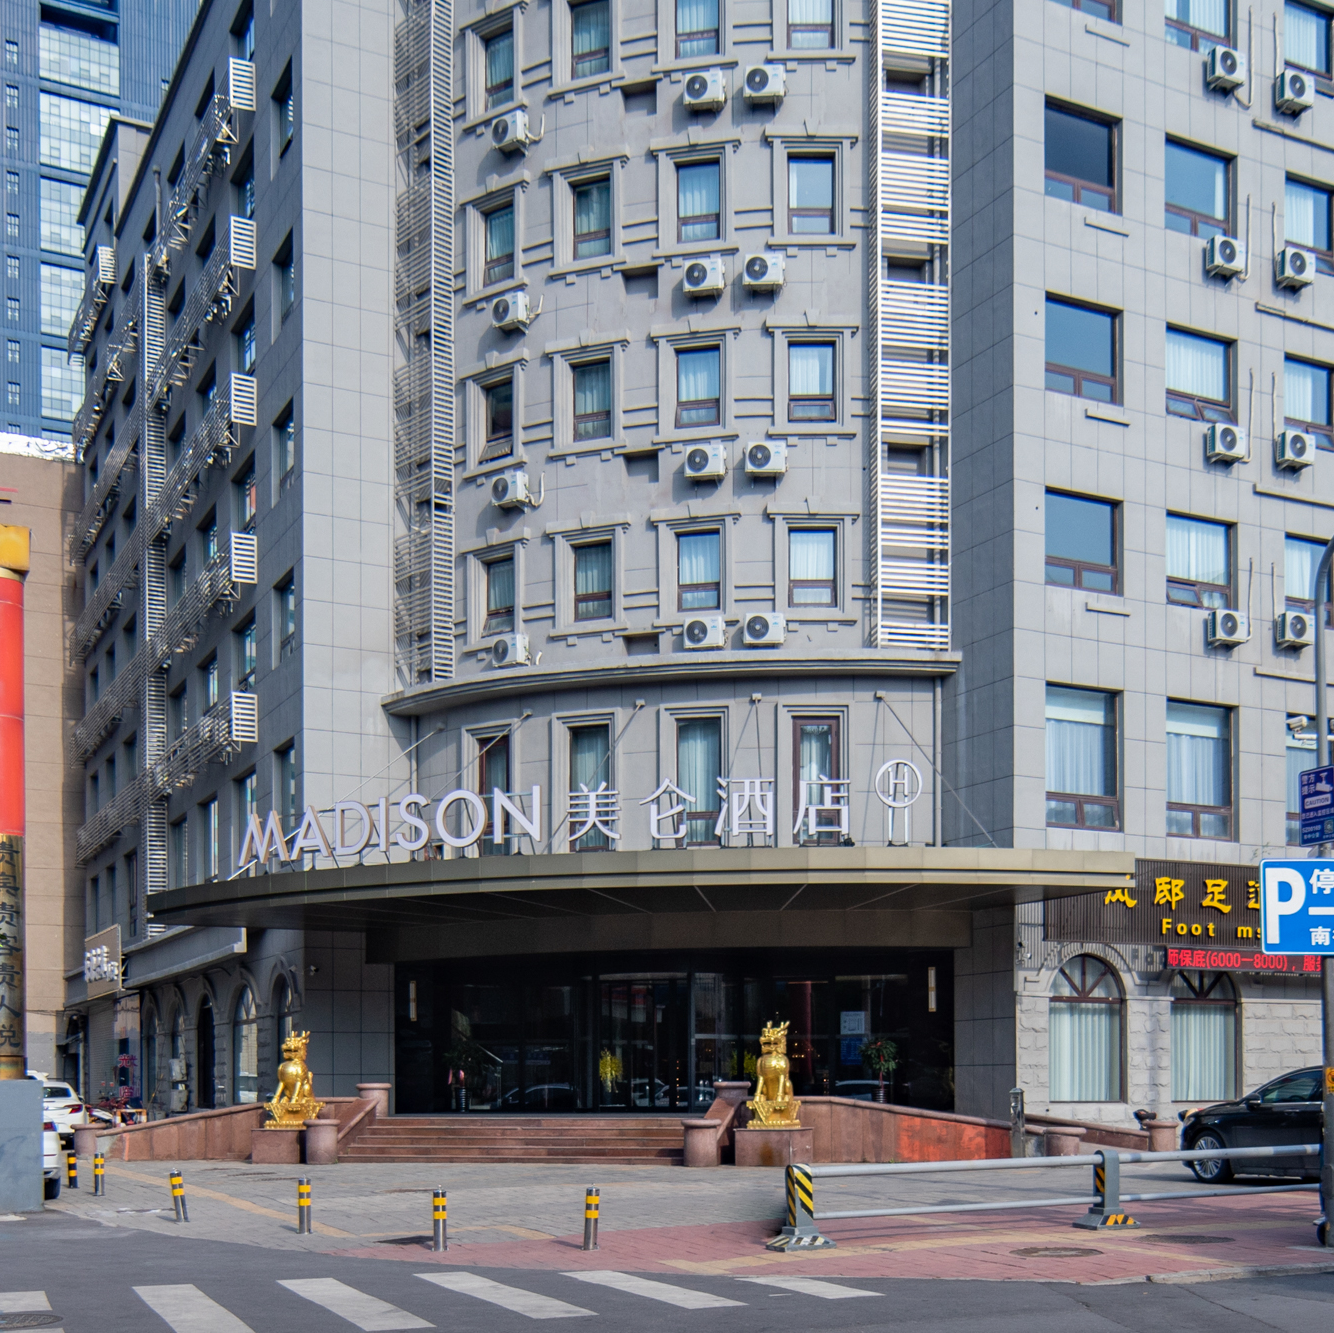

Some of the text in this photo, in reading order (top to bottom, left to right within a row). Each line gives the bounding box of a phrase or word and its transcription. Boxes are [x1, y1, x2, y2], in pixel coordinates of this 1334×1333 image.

[238, 784, 541, 867] MADISON
[566, 774, 851, 842] 美仑酒店
[1305, 797, 1329, 806] CAUTION
[1162, 918, 1215, 937] Foot
[1265, 867, 1306, 944] P
